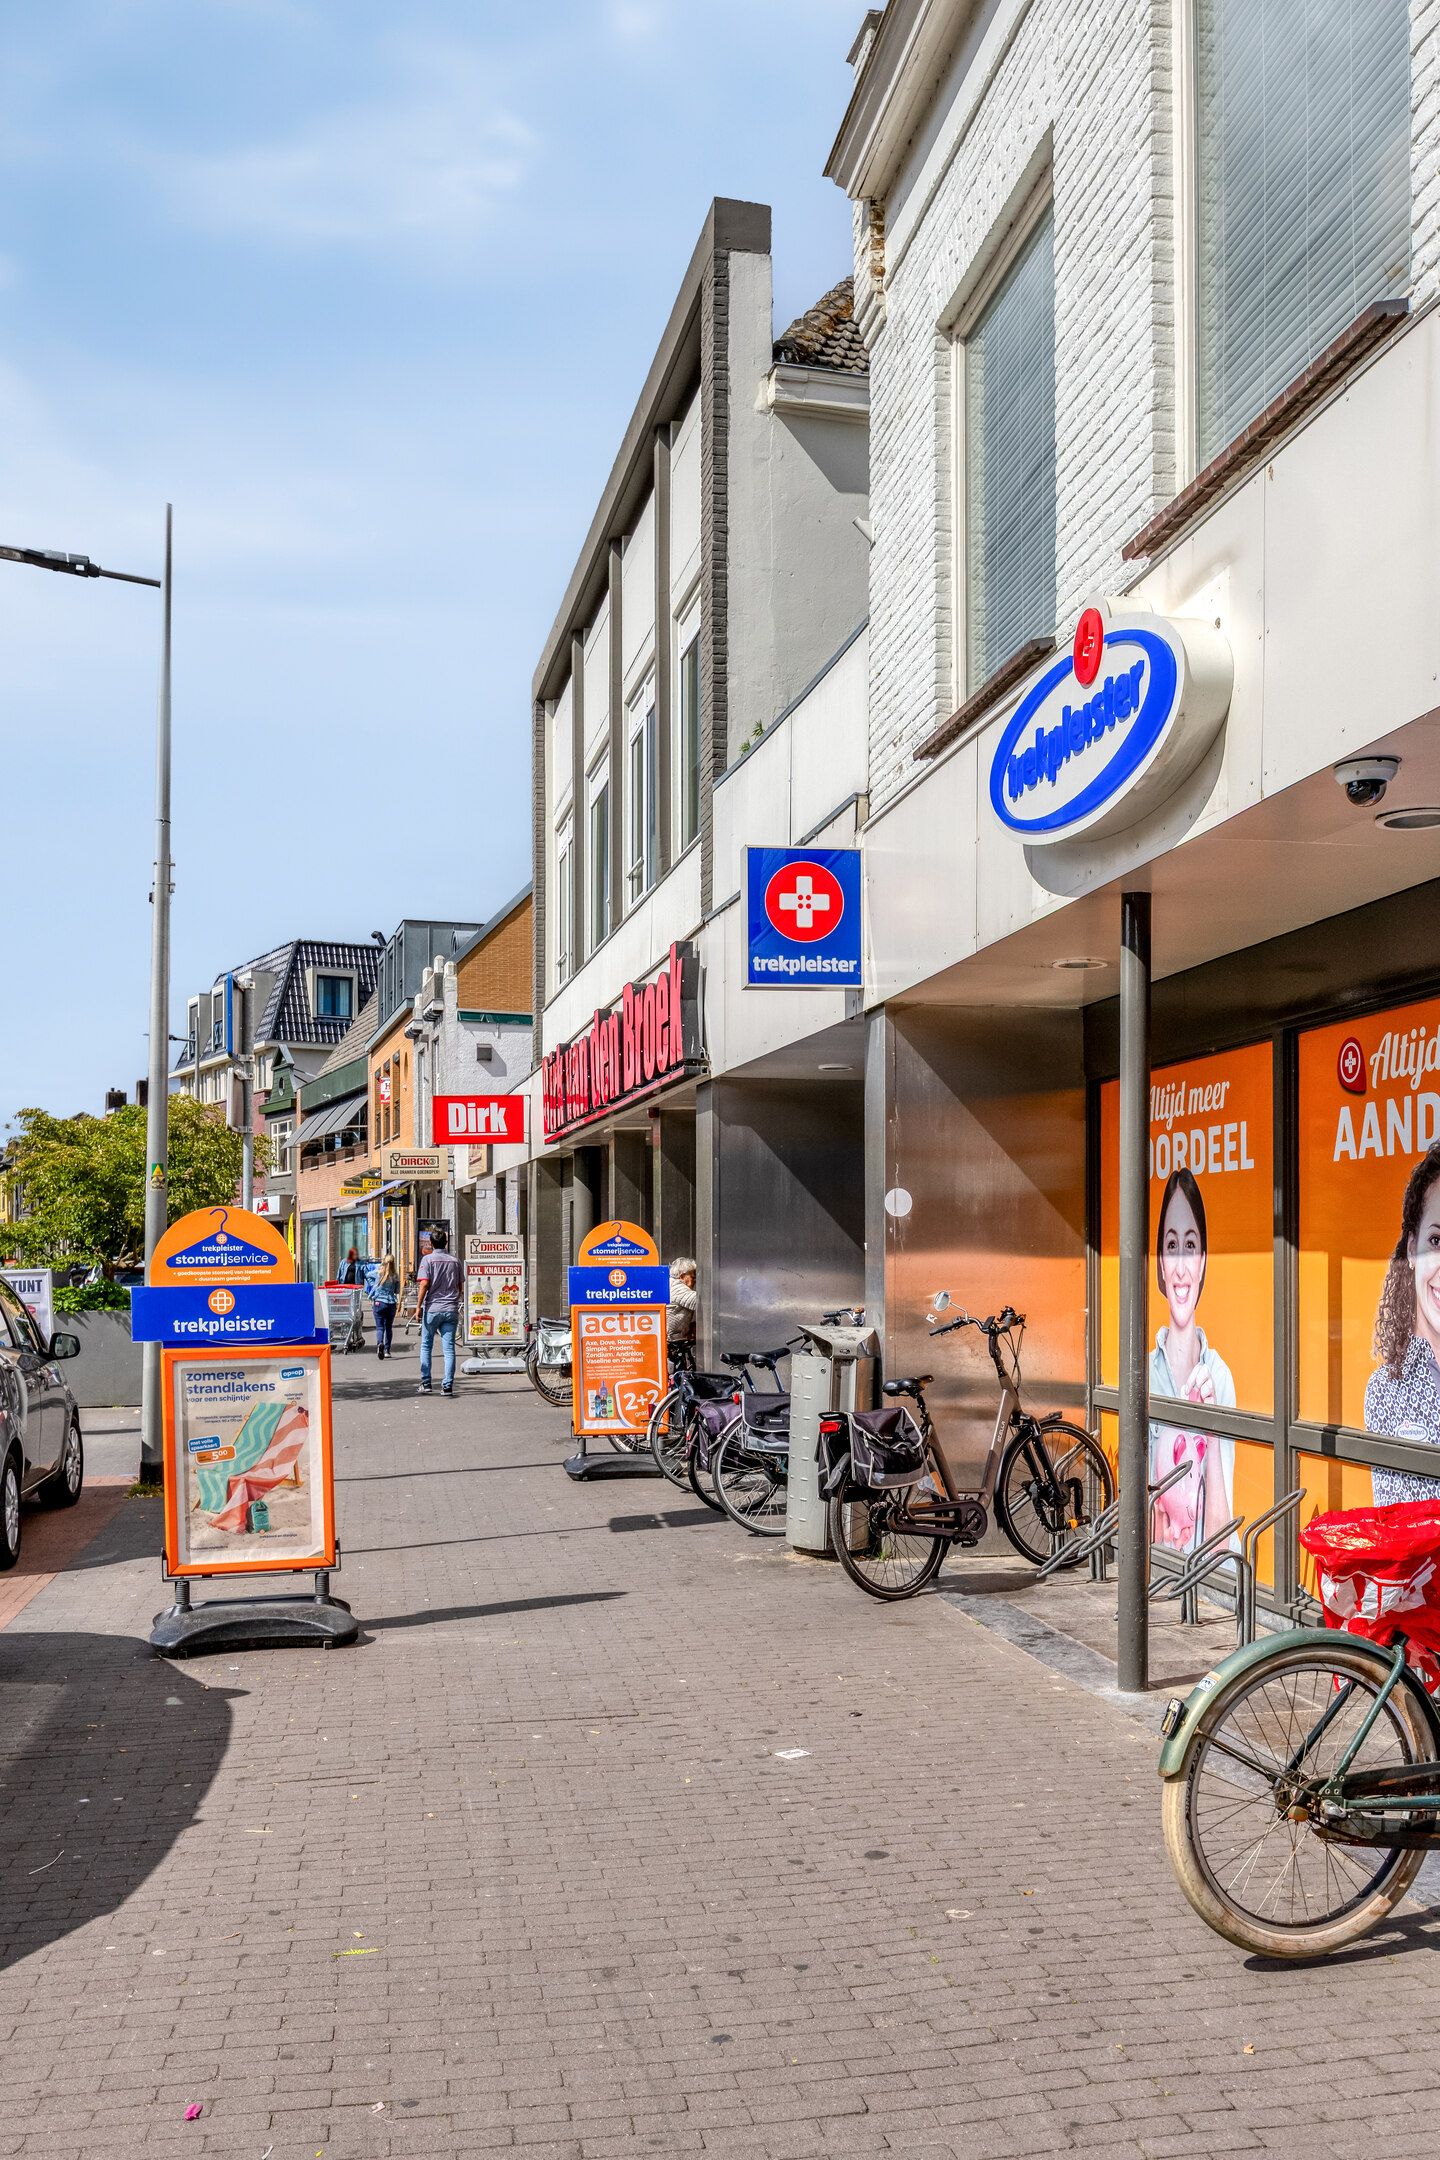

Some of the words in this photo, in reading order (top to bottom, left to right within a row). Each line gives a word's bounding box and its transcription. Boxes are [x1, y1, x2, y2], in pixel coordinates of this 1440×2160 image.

[1008, 660, 1144, 798] trekpleister
[753, 955, 857, 976] trekpleister
[565, 1036, 588, 1121] van
[590, 1008, 620, 1109] den
[623, 940, 684, 1092] Broek
[1188, 1081, 1230, 1115] meer
[448, 1102, 508, 1133] Dirk
[1150, 1121, 1254, 1180] ORDEEL
[400, 1157, 430, 1166] DIRCK
[201, 1245, 243, 1253] trekpleister
[480, 1243, 509, 1251] DIRCK
[592, 1248, 645, 1256] stomerijservice
[175, 1253, 269, 1266] stomerijservice
[469, 1267, 482, 1275] XXL
[484, 1266, 520, 1275] KNALLERS!
[10, 1279, 43, 1292] TUNT
[586, 1287, 653, 1301] trekpleister
[173, 1315, 275, 1336] trekpleister
[585, 1311, 653, 1334] actie
[186, 1370, 245, 1381] zomerse
[186, 1382, 276, 1395] strandlakens
